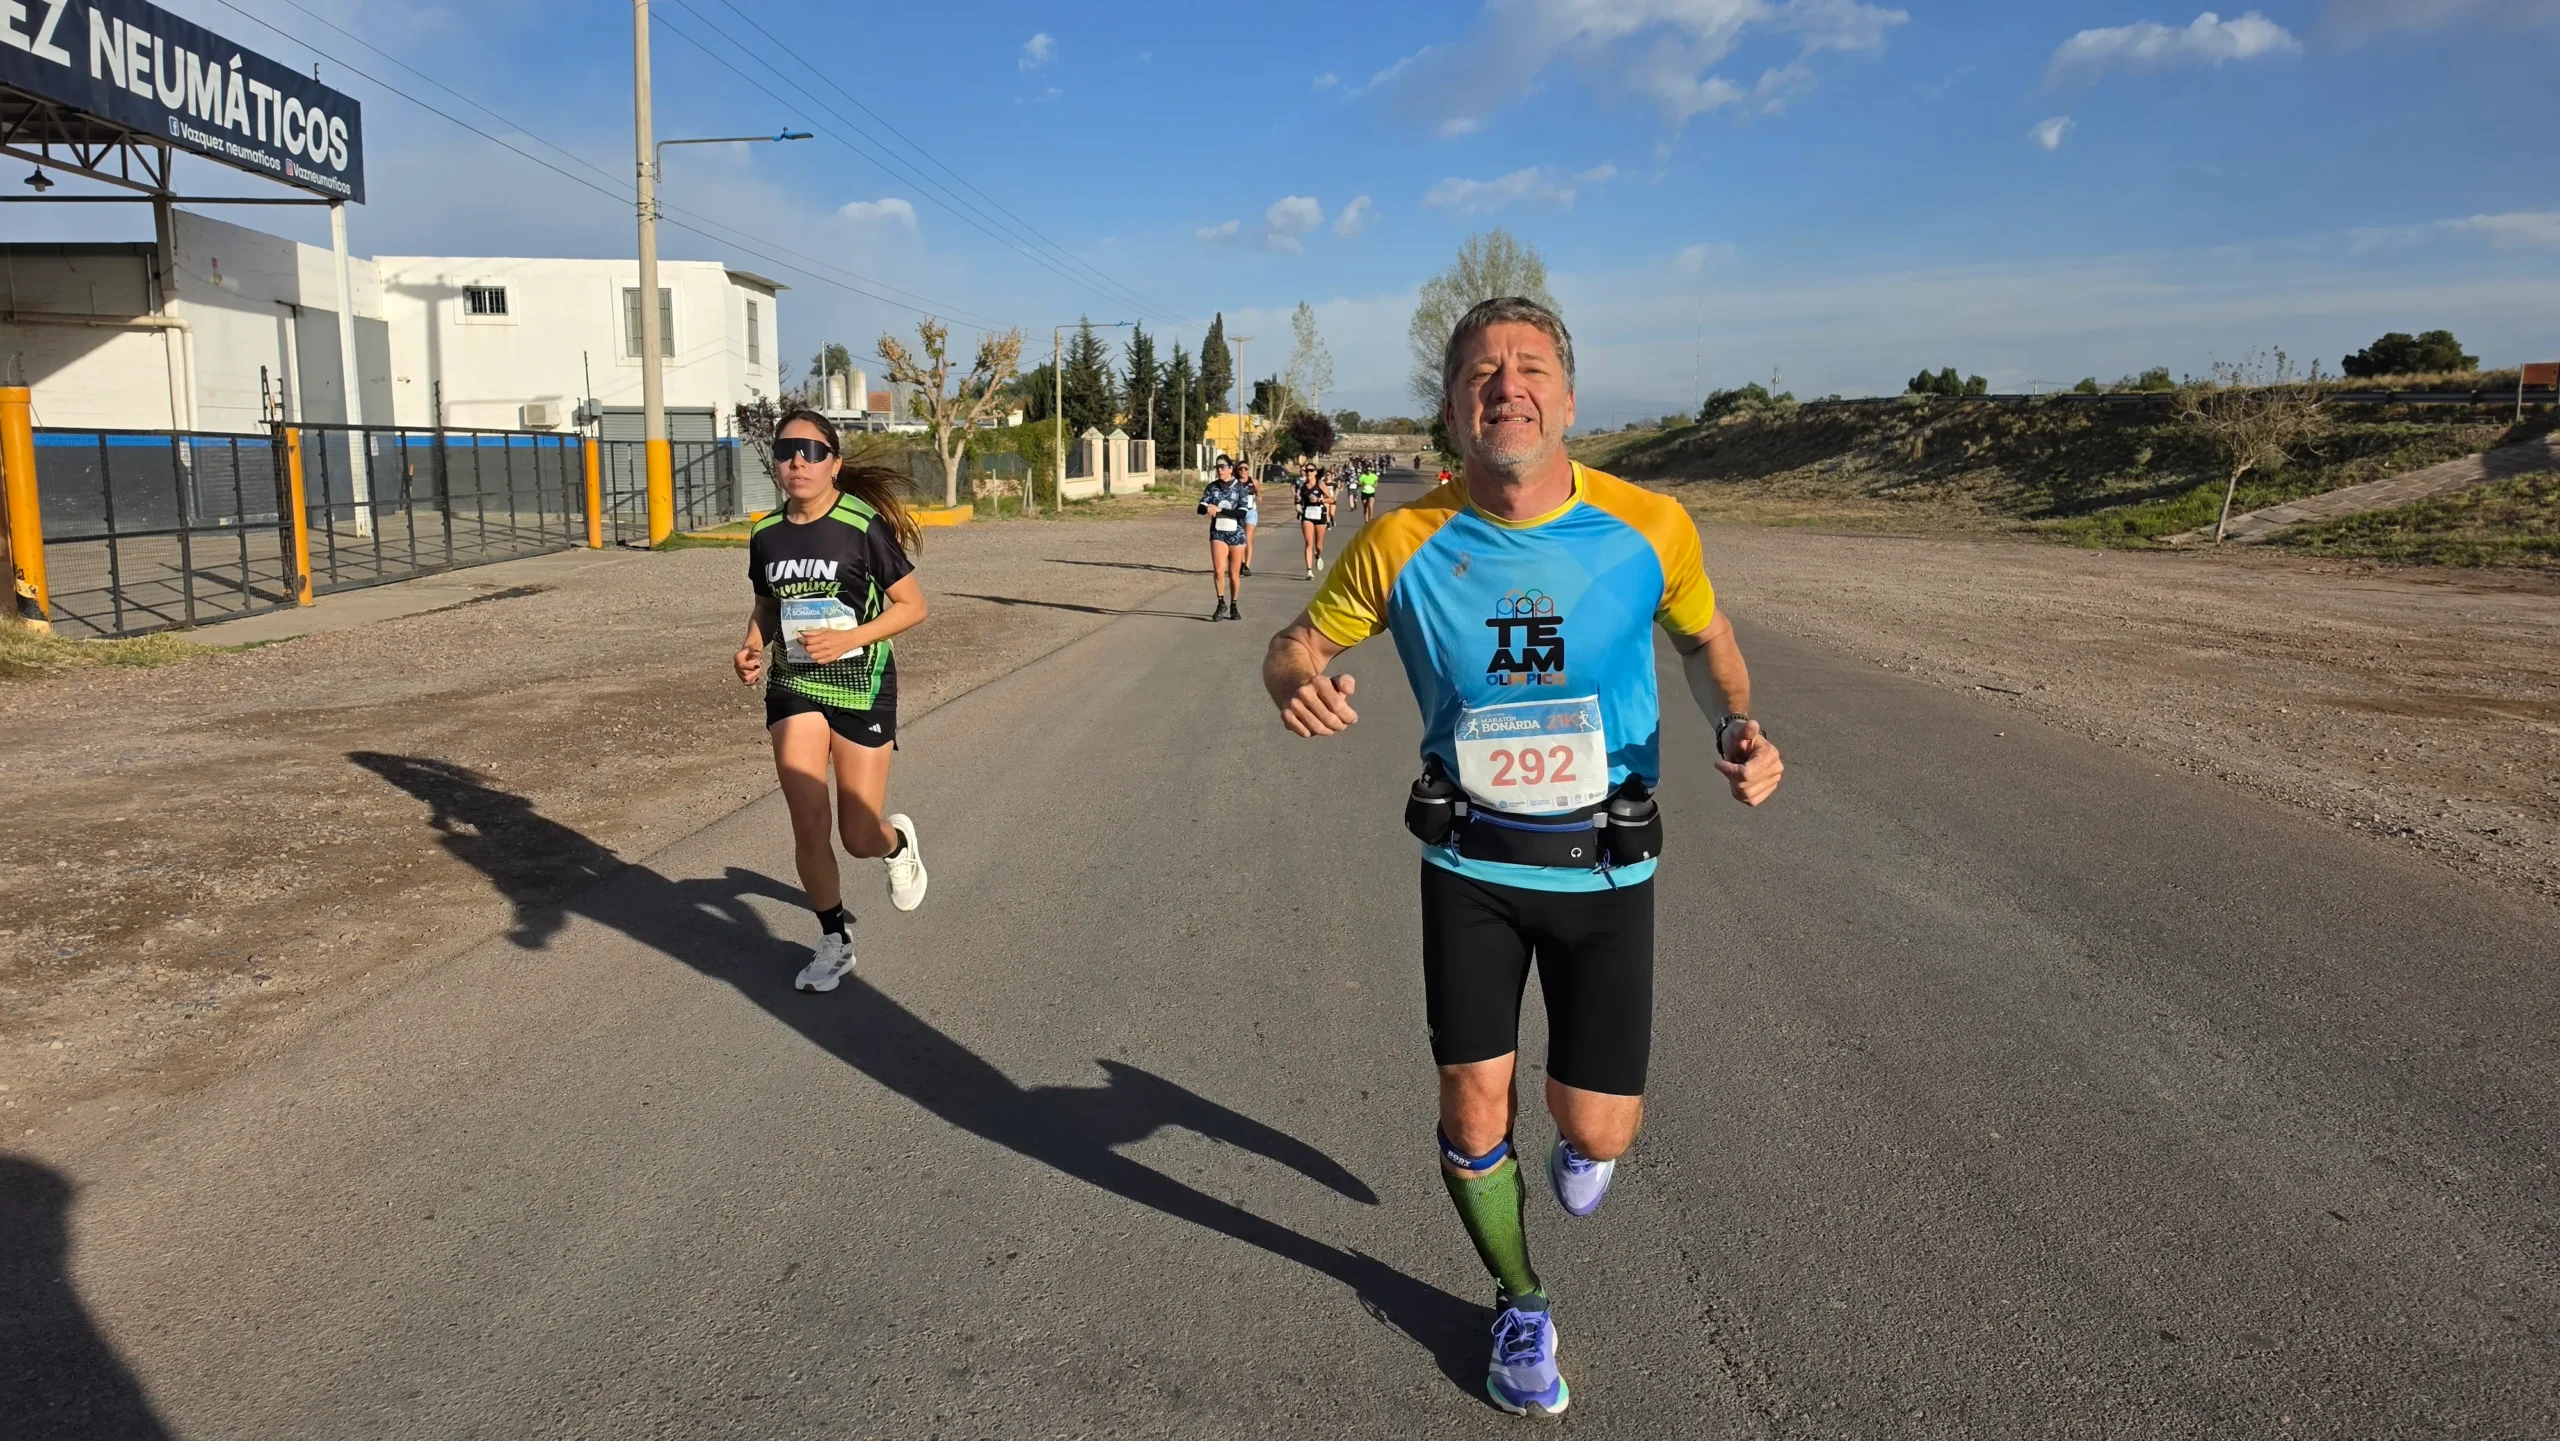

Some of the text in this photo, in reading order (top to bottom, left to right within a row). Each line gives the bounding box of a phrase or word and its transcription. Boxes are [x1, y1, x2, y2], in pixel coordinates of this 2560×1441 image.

[89, 8, 348, 172] NEUMÁTICOS
[181, 122, 281, 171] Vazquez neumaticos
[293, 162, 351, 195] Vazneumaticos
[1486, 674, 1565, 686] OLIMPICO
[1482, 720, 1541, 732] BONARDA
[1546, 712, 1579, 729] 21K
[1489, 745, 1577, 787] 292
